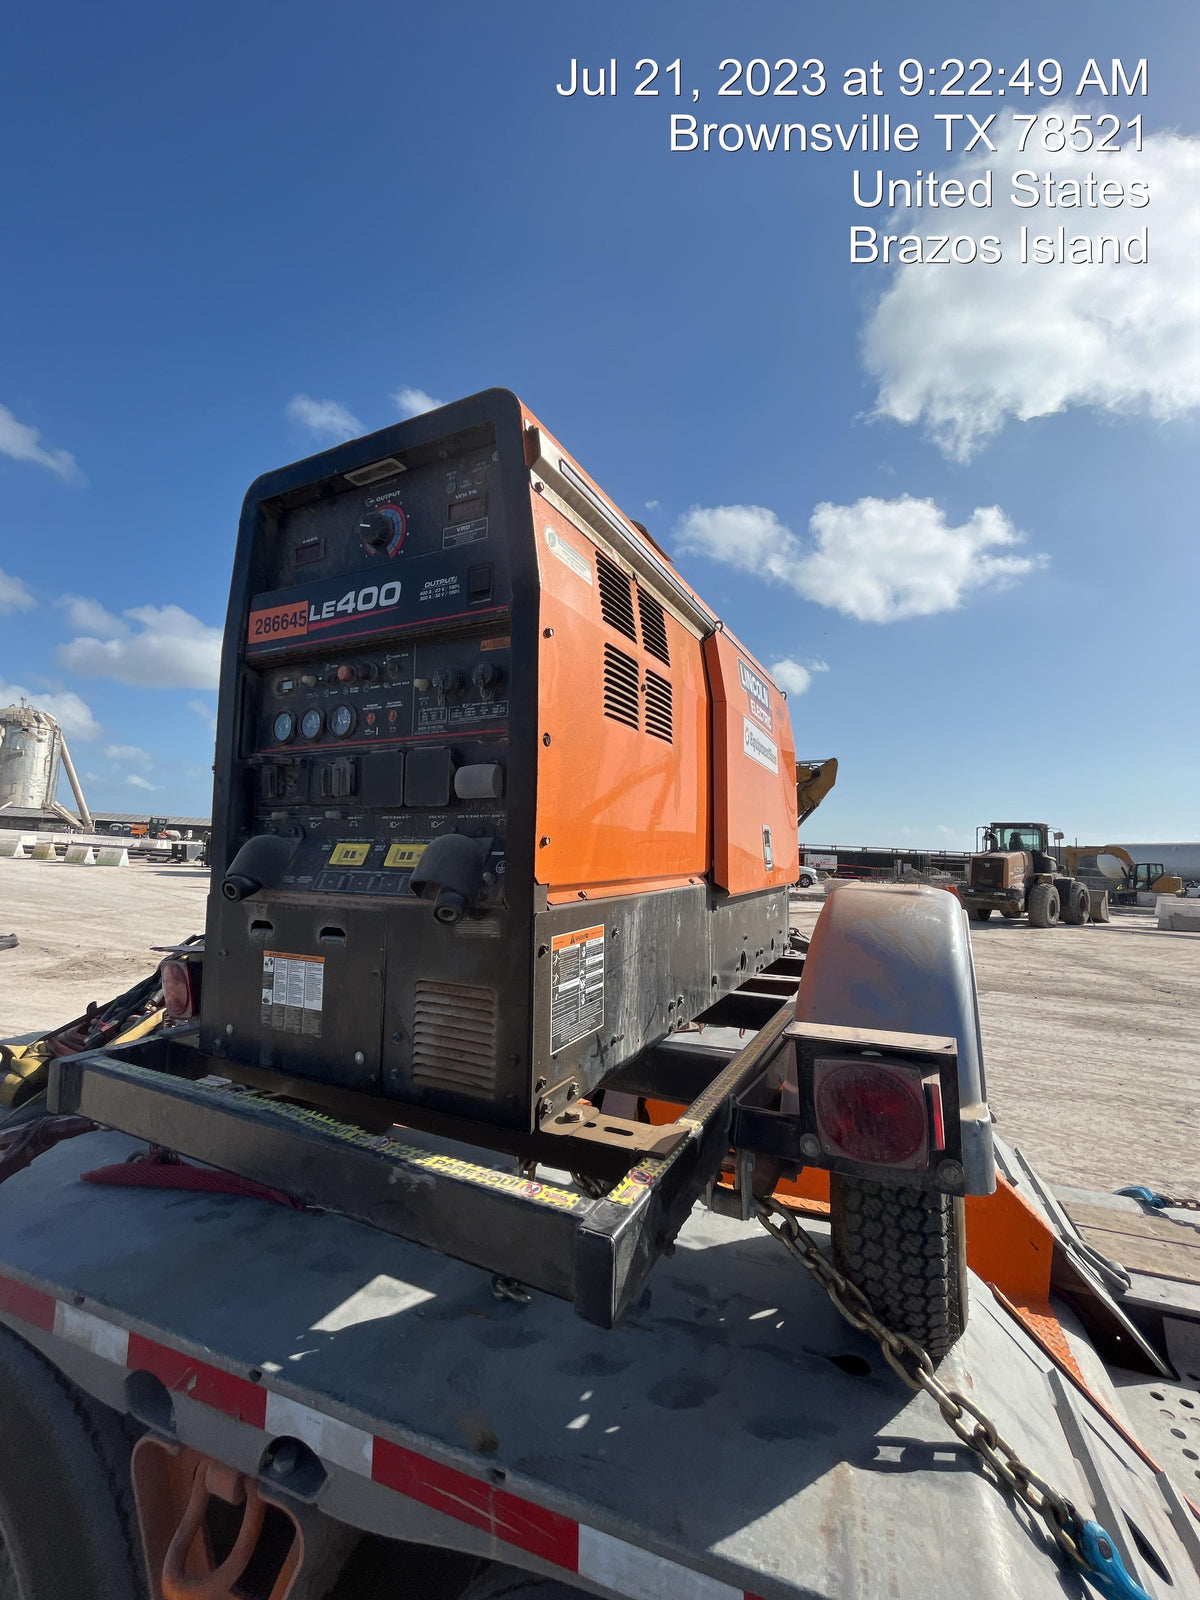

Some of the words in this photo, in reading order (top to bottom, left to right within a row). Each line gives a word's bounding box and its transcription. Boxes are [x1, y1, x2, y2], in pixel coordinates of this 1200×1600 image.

[375, 490, 401, 502] OUTPUT
[309, 581, 402, 622] LE400
[255, 609, 307, 635] 286645
[739, 663, 769, 708] LINCOLN
[750, 698, 772, 731] ELECTRIC
